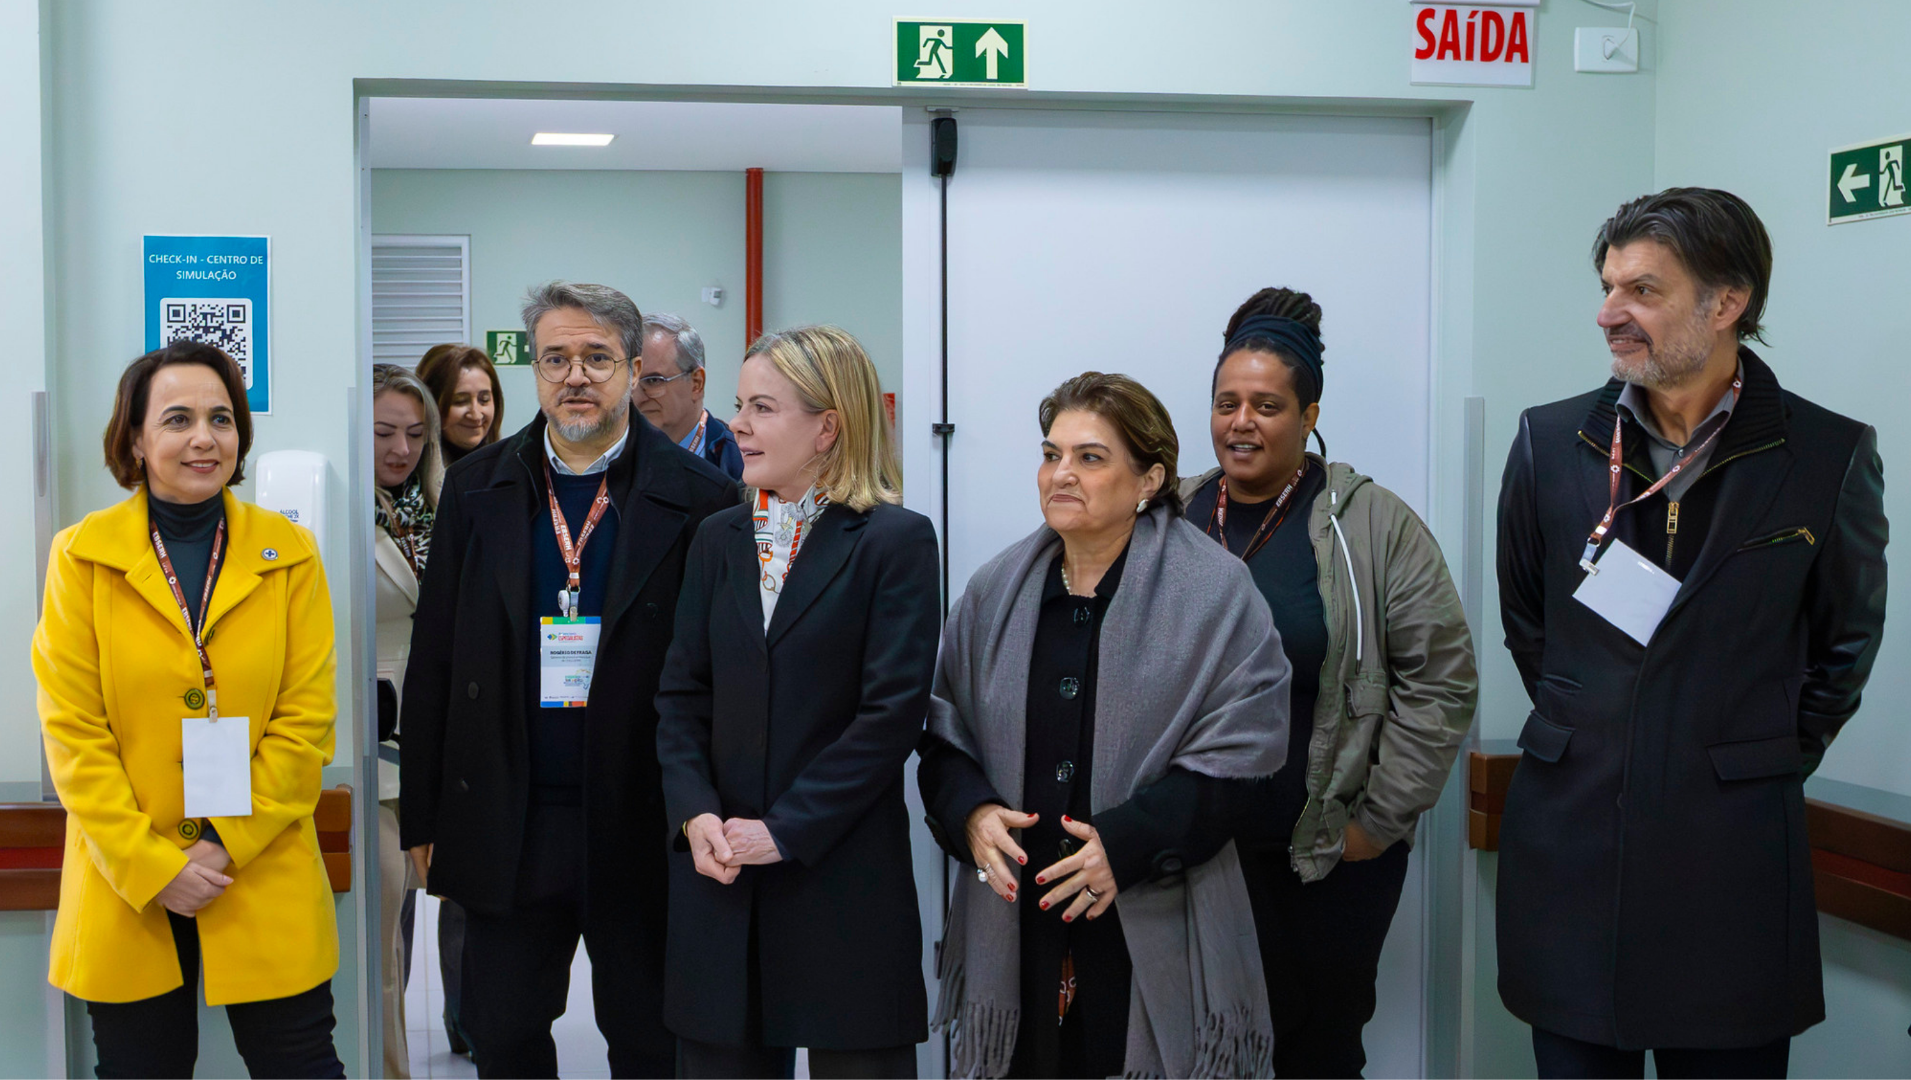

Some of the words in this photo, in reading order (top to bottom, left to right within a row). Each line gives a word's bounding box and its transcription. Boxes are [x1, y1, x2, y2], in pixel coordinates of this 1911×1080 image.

[149, 254, 198, 264] CHECK-IN
[206, 255, 248, 265] CENTRO
[250, 255, 264, 265] DE
[176, 268, 237, 281] SIMULAÇÃO
[1276, 484, 1293, 507] EBSERH
[152, 531, 167, 559] EBSERH
[561, 524, 572, 551] EBSERH
